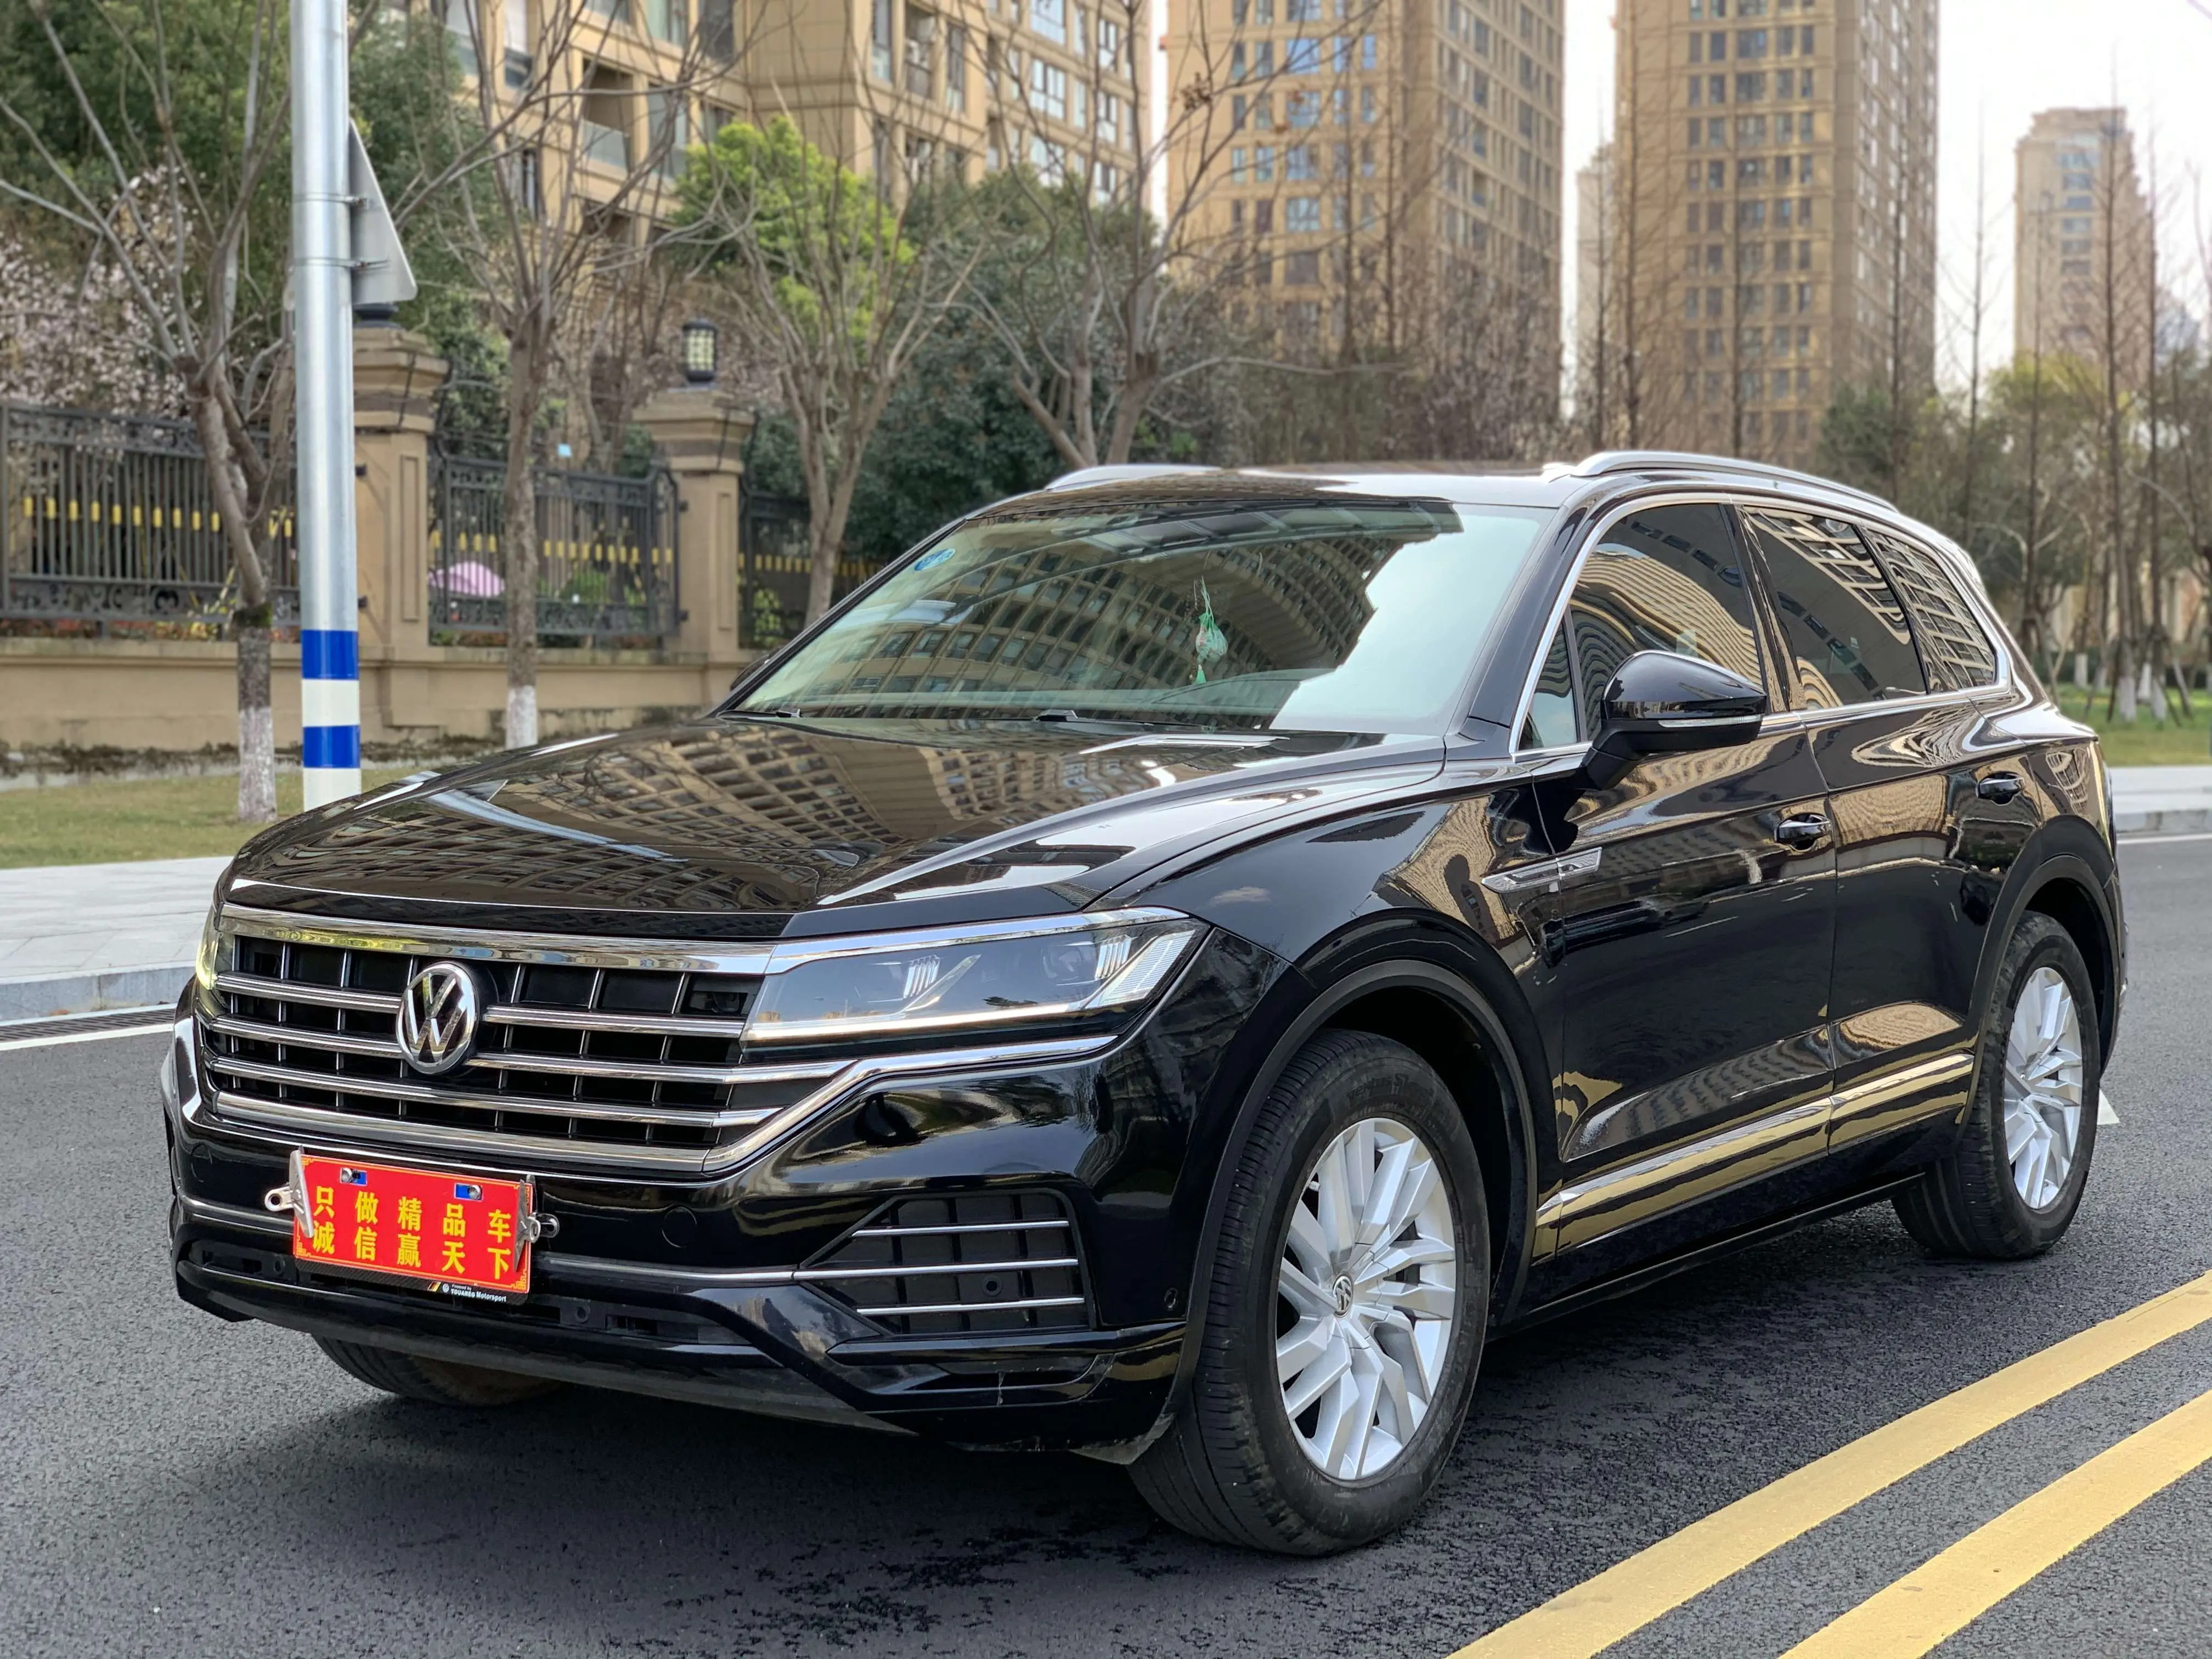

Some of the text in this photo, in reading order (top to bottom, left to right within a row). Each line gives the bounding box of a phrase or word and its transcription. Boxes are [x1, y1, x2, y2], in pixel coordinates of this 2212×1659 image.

[313, 1185, 512, 1244] 只做精品车
[312, 1220, 512, 1280] 诚信赢天下
[476, 1291, 507, 1302] Motorsport
